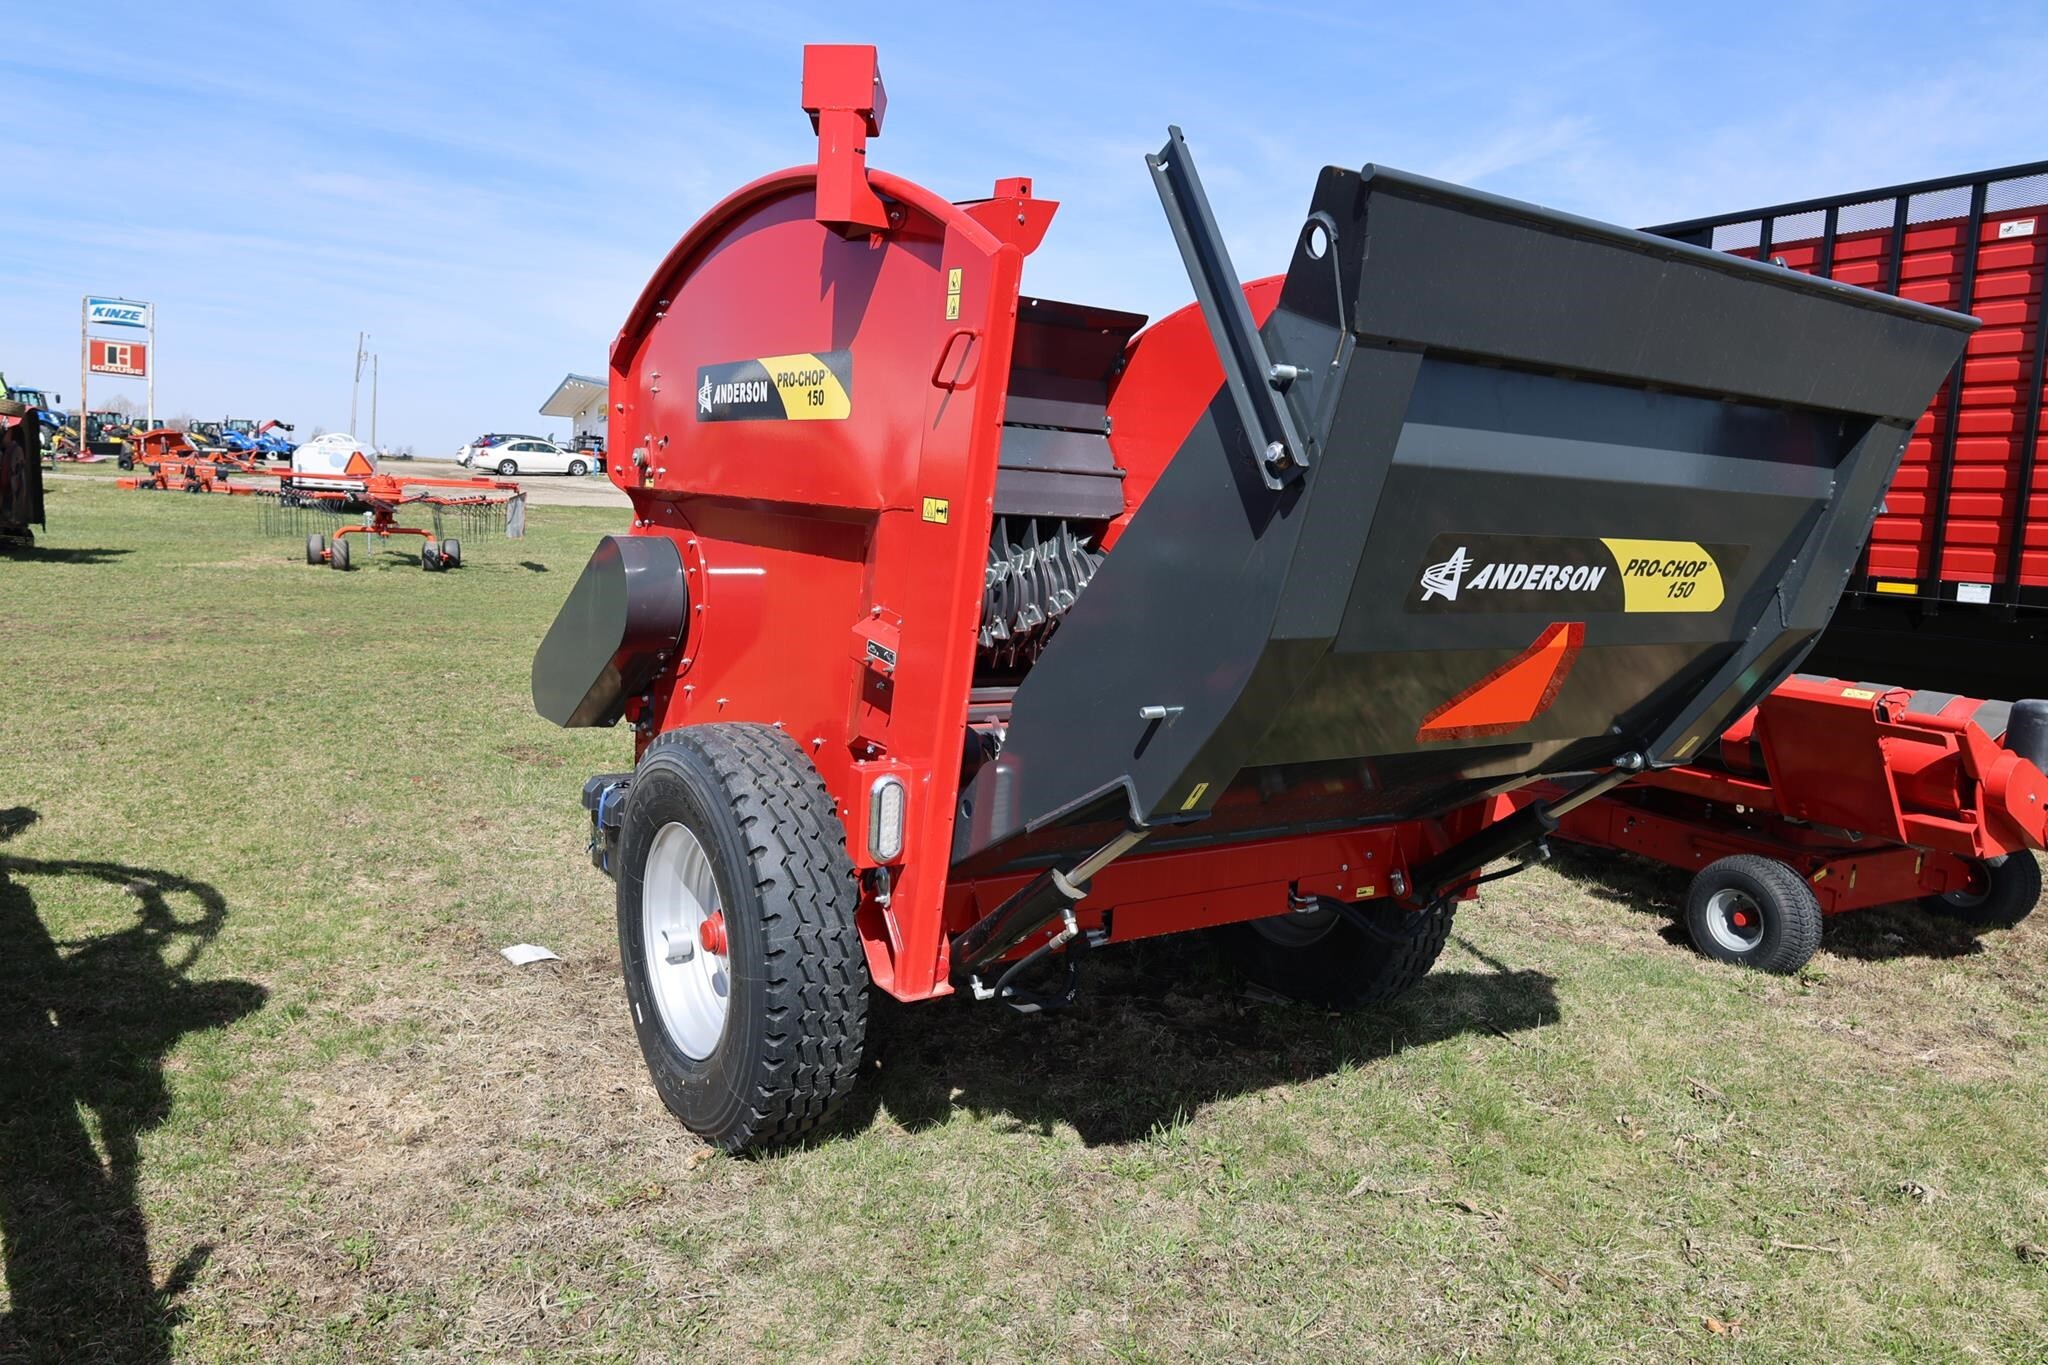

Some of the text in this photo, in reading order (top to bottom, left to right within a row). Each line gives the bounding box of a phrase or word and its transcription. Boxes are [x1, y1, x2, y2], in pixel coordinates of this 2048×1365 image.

[92, 307, 142, 321] KINZE
[91, 364, 144, 375] KRAUSE
[777, 370, 825, 388] PRO-CHOP
[712, 381, 768, 404] ANDERSON
[807, 390, 825, 406] 150
[1465, 563, 1607, 591] ANDERSON
[1623, 558, 1707, 578] PRO-CHOP
[1666, 581, 1696, 599] 150
